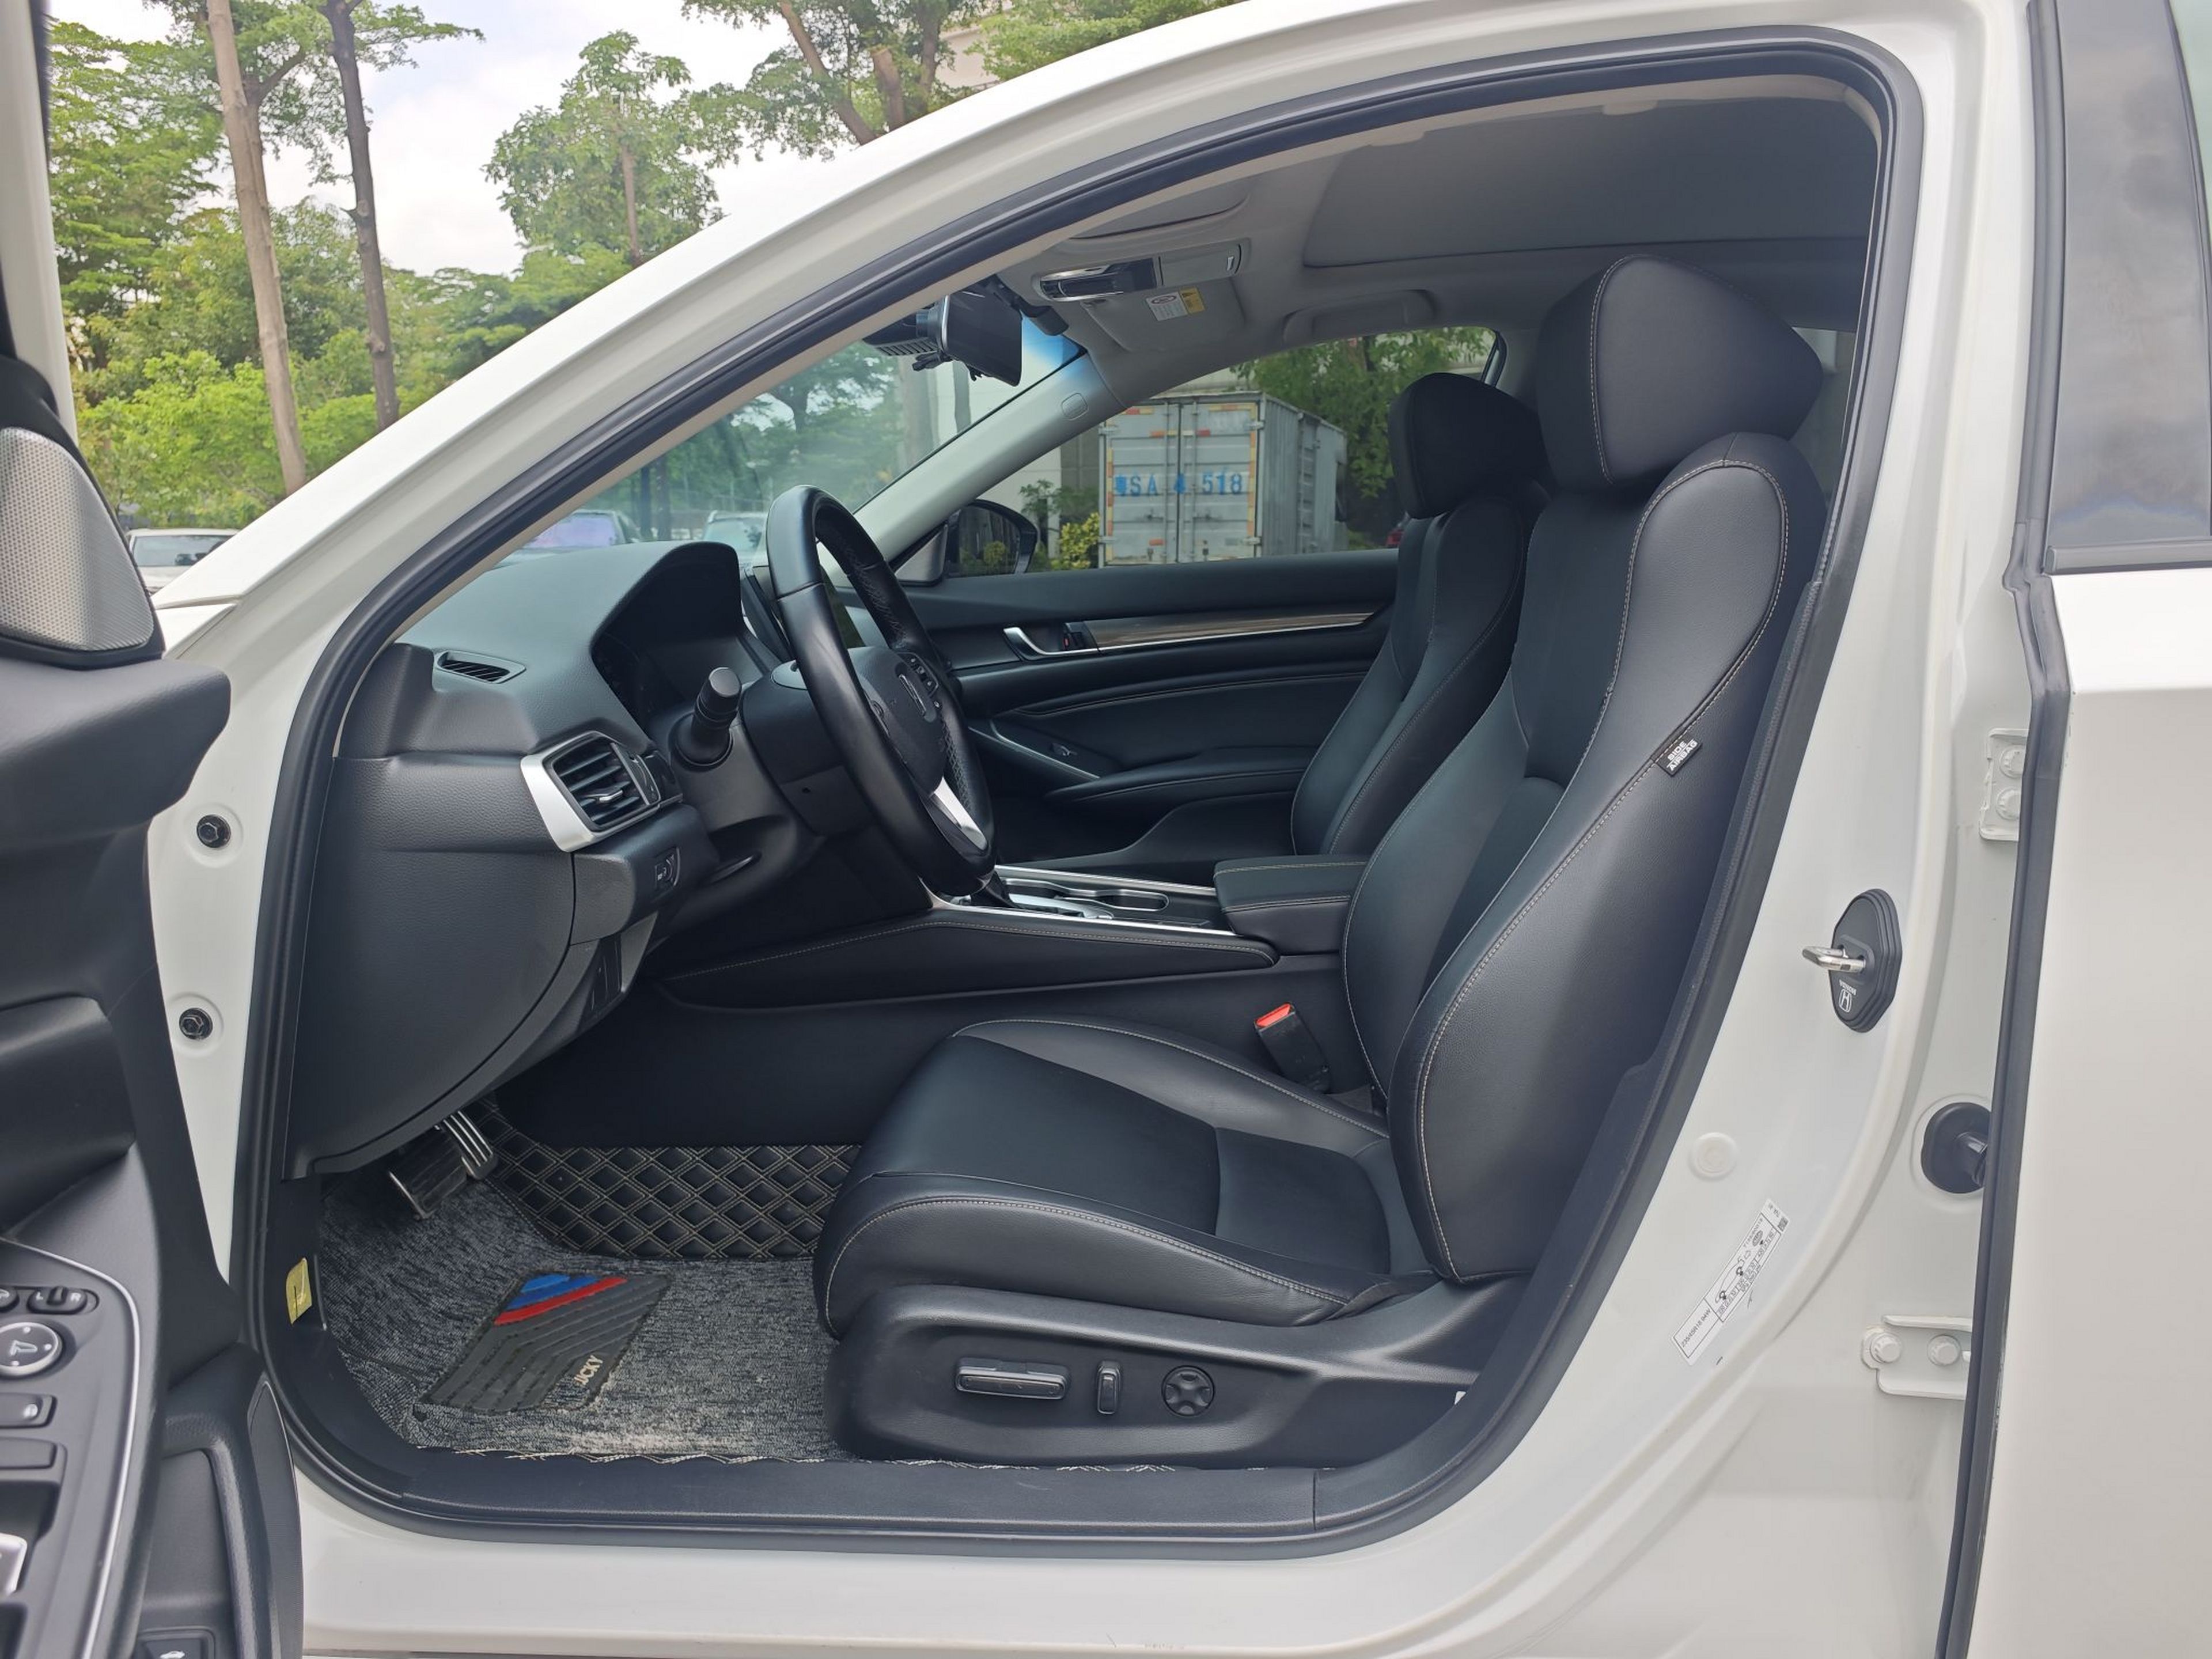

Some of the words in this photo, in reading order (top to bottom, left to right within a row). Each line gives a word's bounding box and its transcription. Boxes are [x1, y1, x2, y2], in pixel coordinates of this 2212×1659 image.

[1202, 472, 1242, 495] 518
[1667, 741, 1687, 760] SIDE
[1669, 740, 1698, 771] AIRBAG
[36, 1291, 44, 1301] L
[70, 1292, 82, 1302] R
